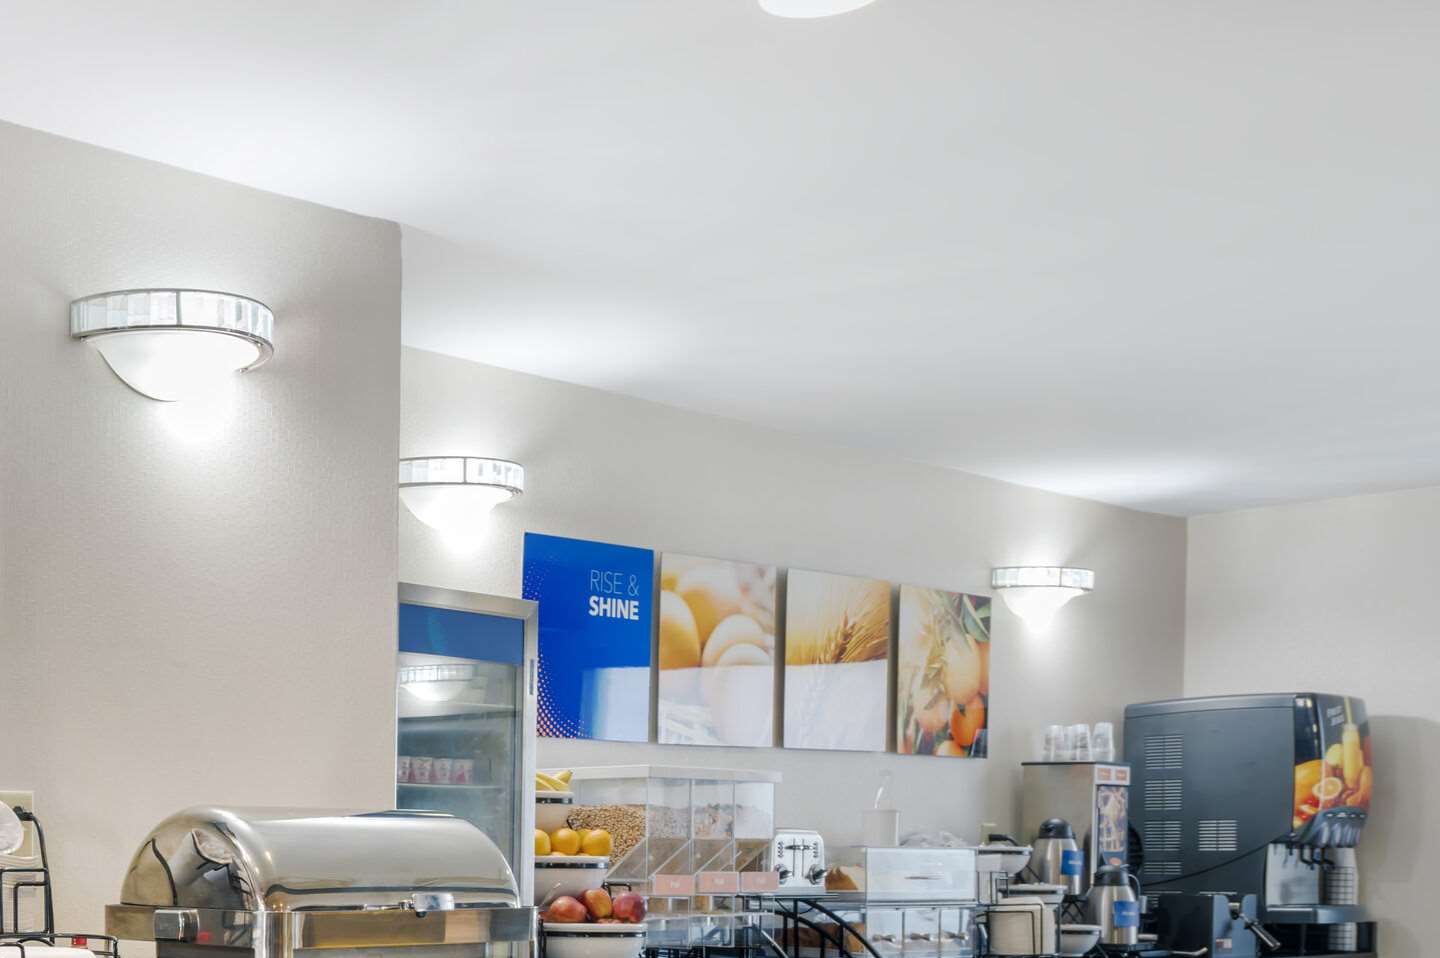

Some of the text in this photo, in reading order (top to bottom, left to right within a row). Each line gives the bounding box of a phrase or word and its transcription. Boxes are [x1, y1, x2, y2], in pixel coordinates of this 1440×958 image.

[590, 569, 640, 597] RISE &
[588, 595, 640, 621] SHINE
